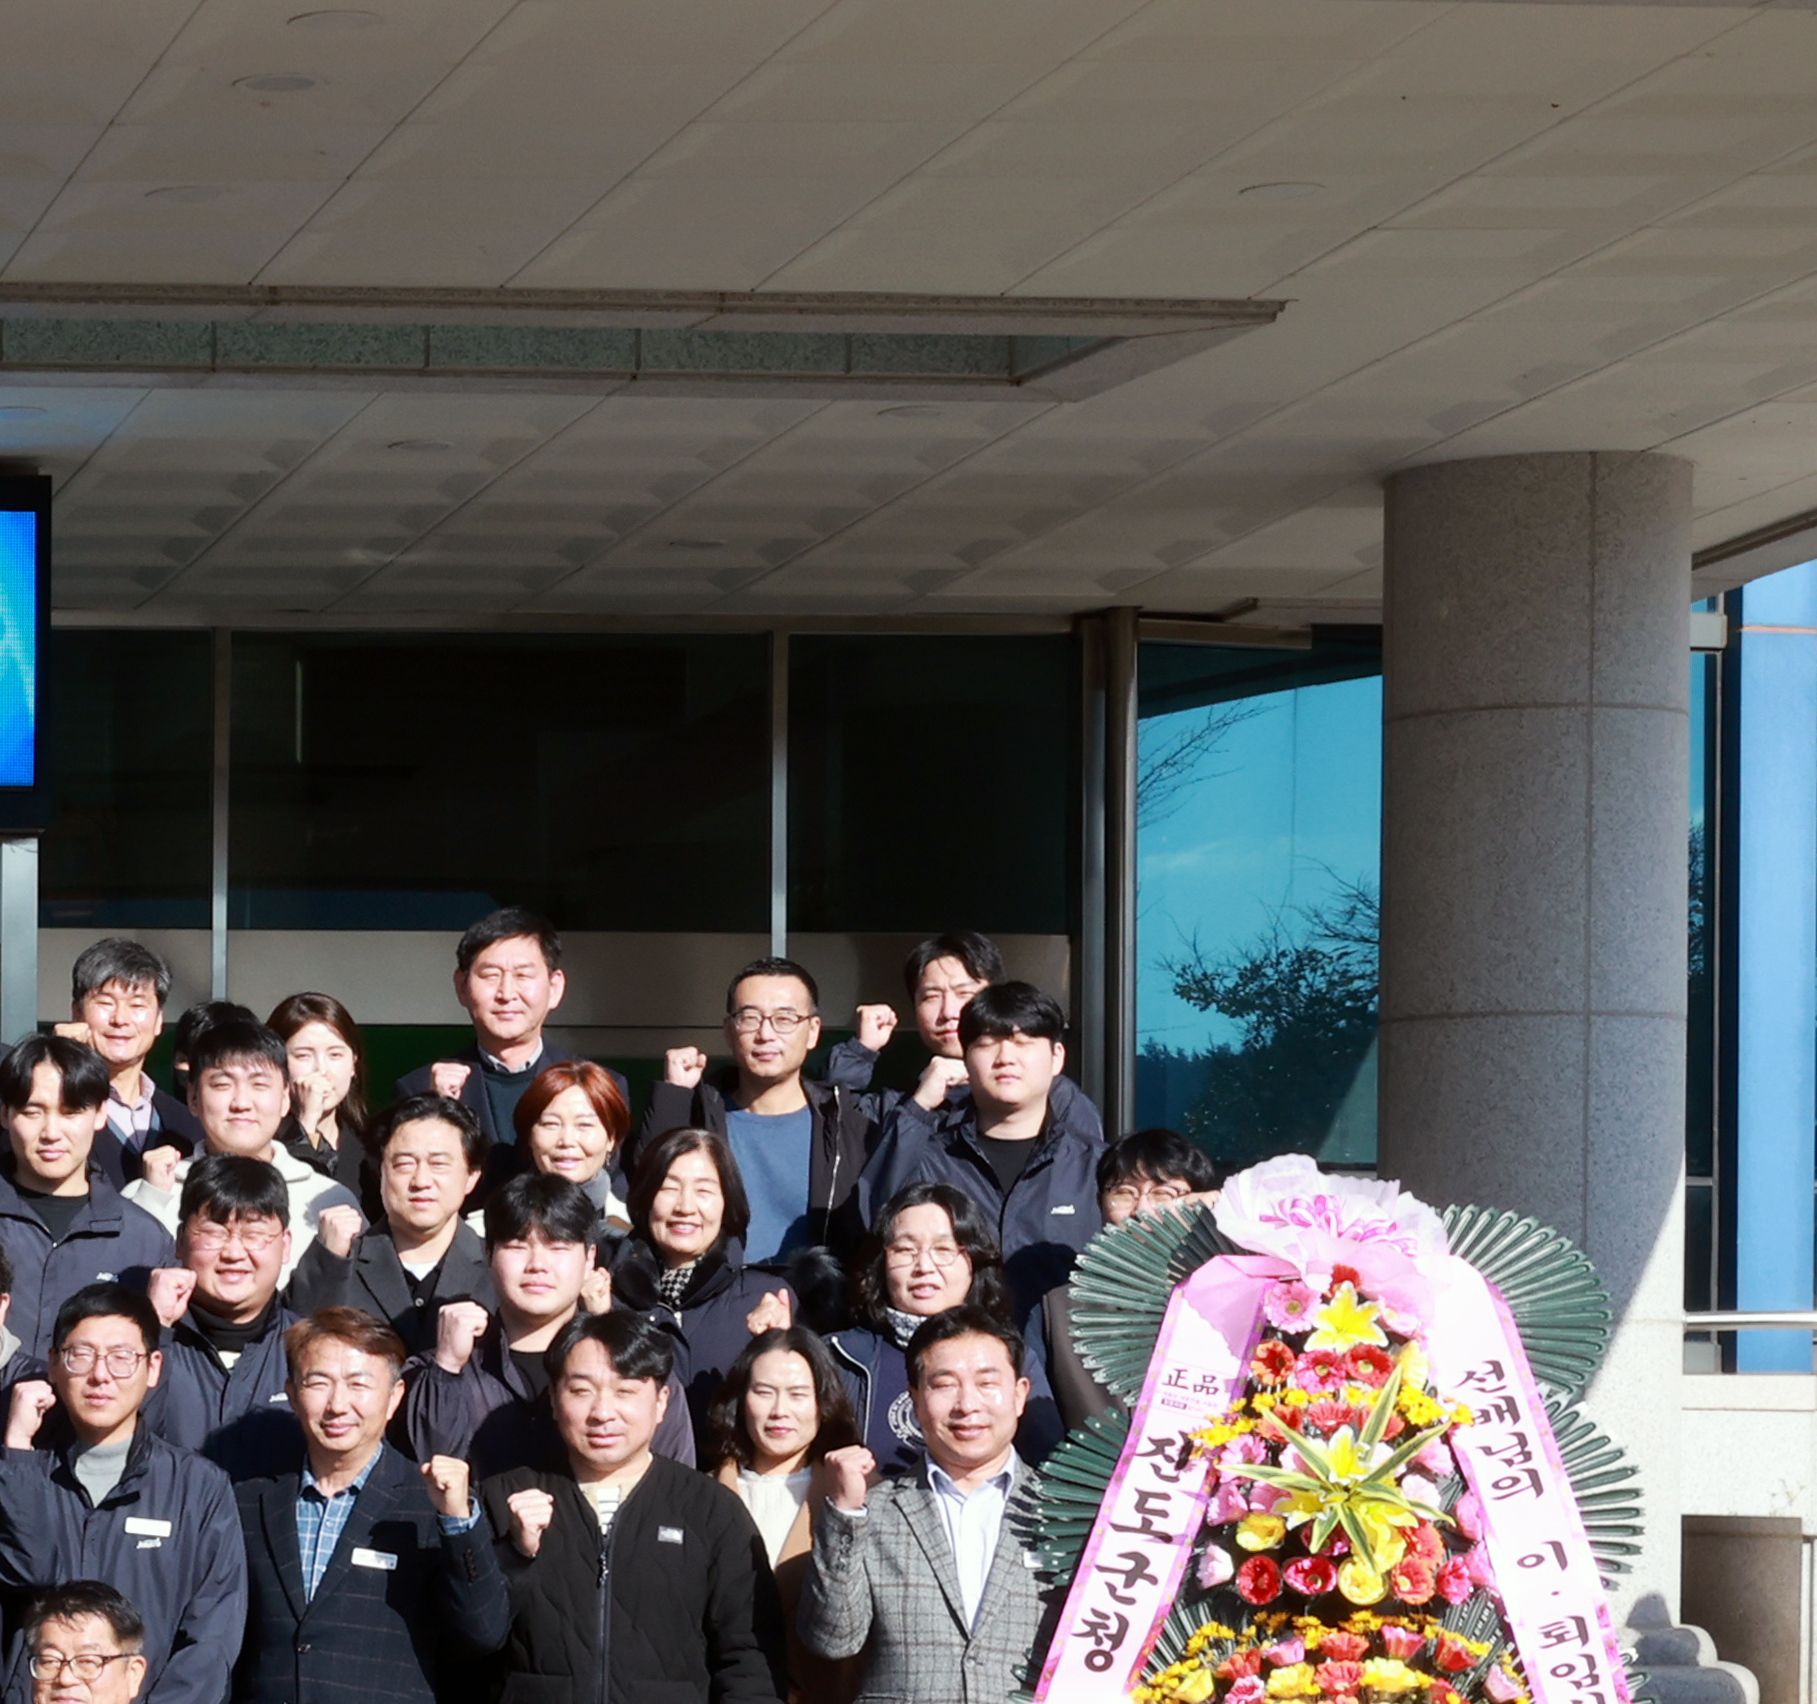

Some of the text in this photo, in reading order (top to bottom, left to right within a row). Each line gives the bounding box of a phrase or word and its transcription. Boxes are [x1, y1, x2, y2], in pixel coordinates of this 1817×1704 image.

[1161, 1368, 1219, 1395] 正品
[1452, 1360, 1544, 1500] 선배님의
[1517, 1541, 1568, 1571] 이
[1071, 1430, 1194, 1673] 진도군청
